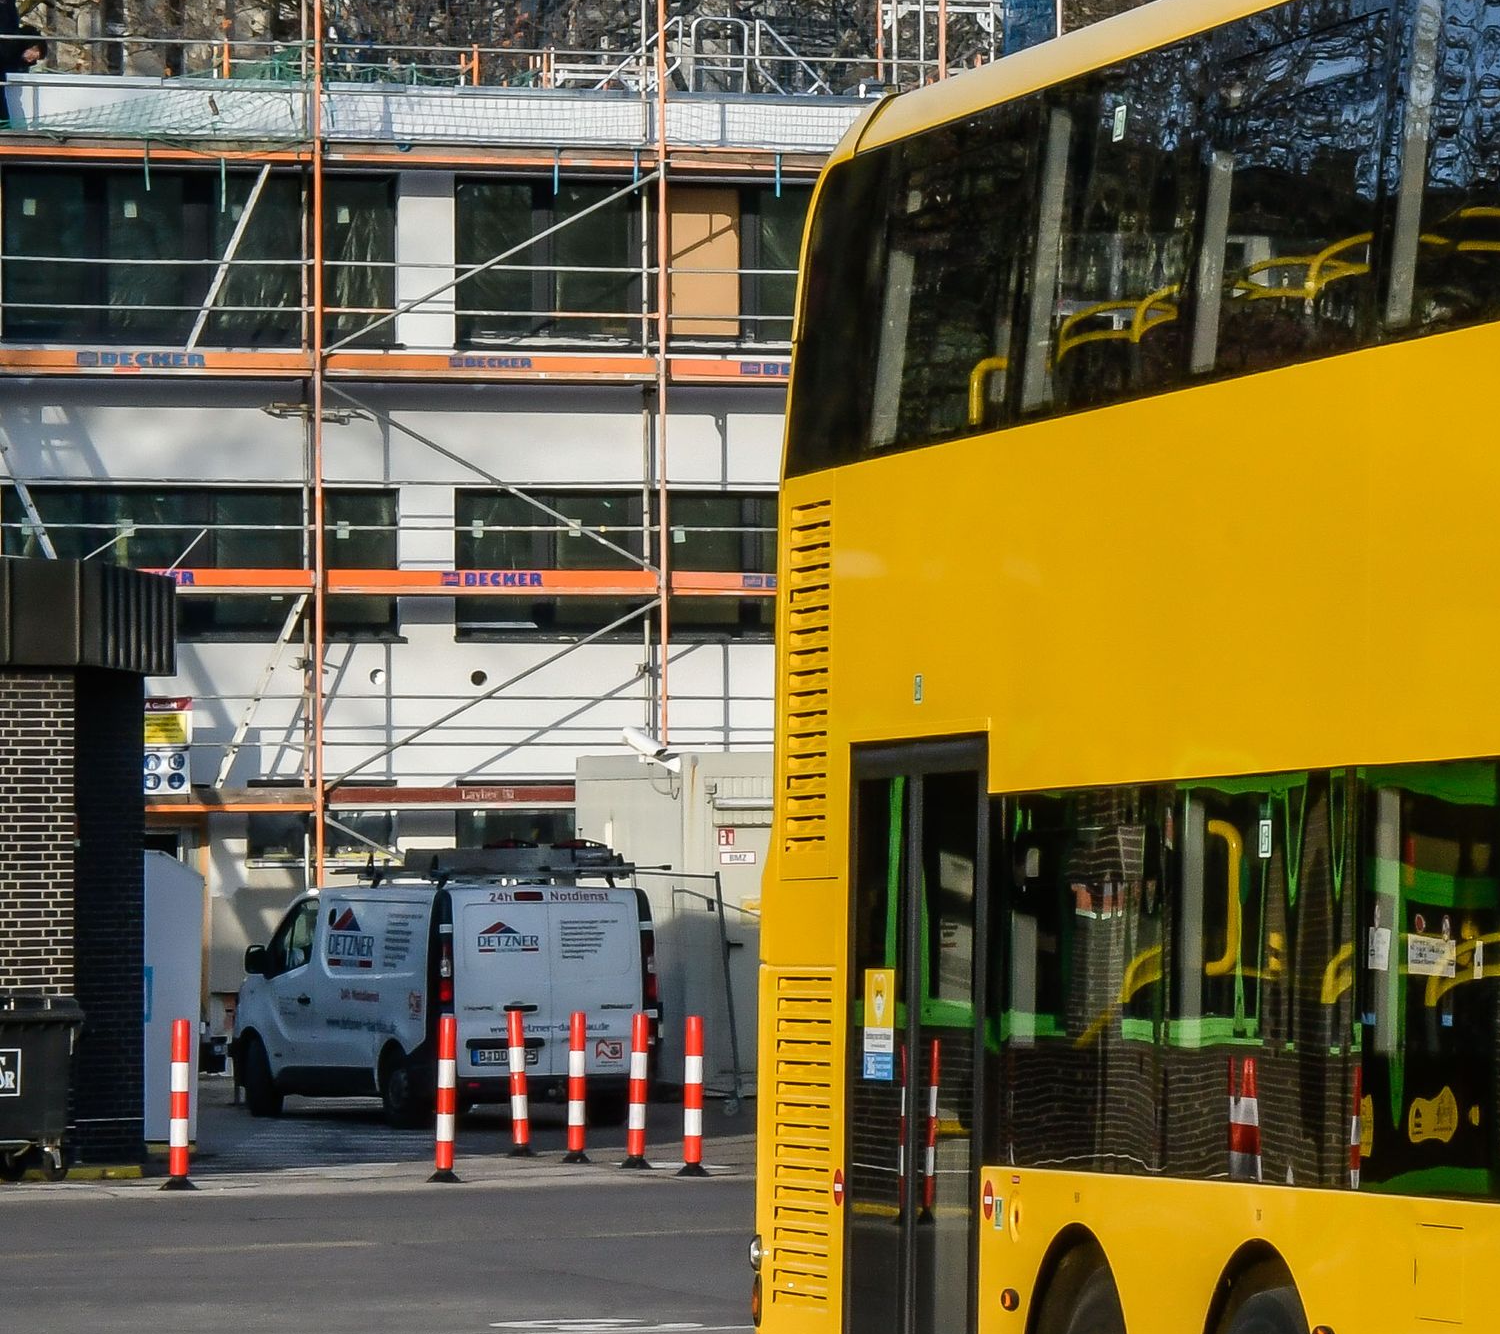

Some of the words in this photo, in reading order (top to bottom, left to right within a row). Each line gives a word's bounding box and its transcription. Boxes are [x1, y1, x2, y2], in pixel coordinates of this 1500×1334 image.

[100, 352, 205, 367] BECKER
[465, 357, 532, 368] BECKER
[464, 572, 543, 586] BECKER
[461, 789, 499, 800] Layher
[489, 892, 512, 902] 24h
[551, 891, 608, 902] Notdienst
[328, 934, 375, 957] DETZNER
[478, 935, 539, 947] DETZNER
